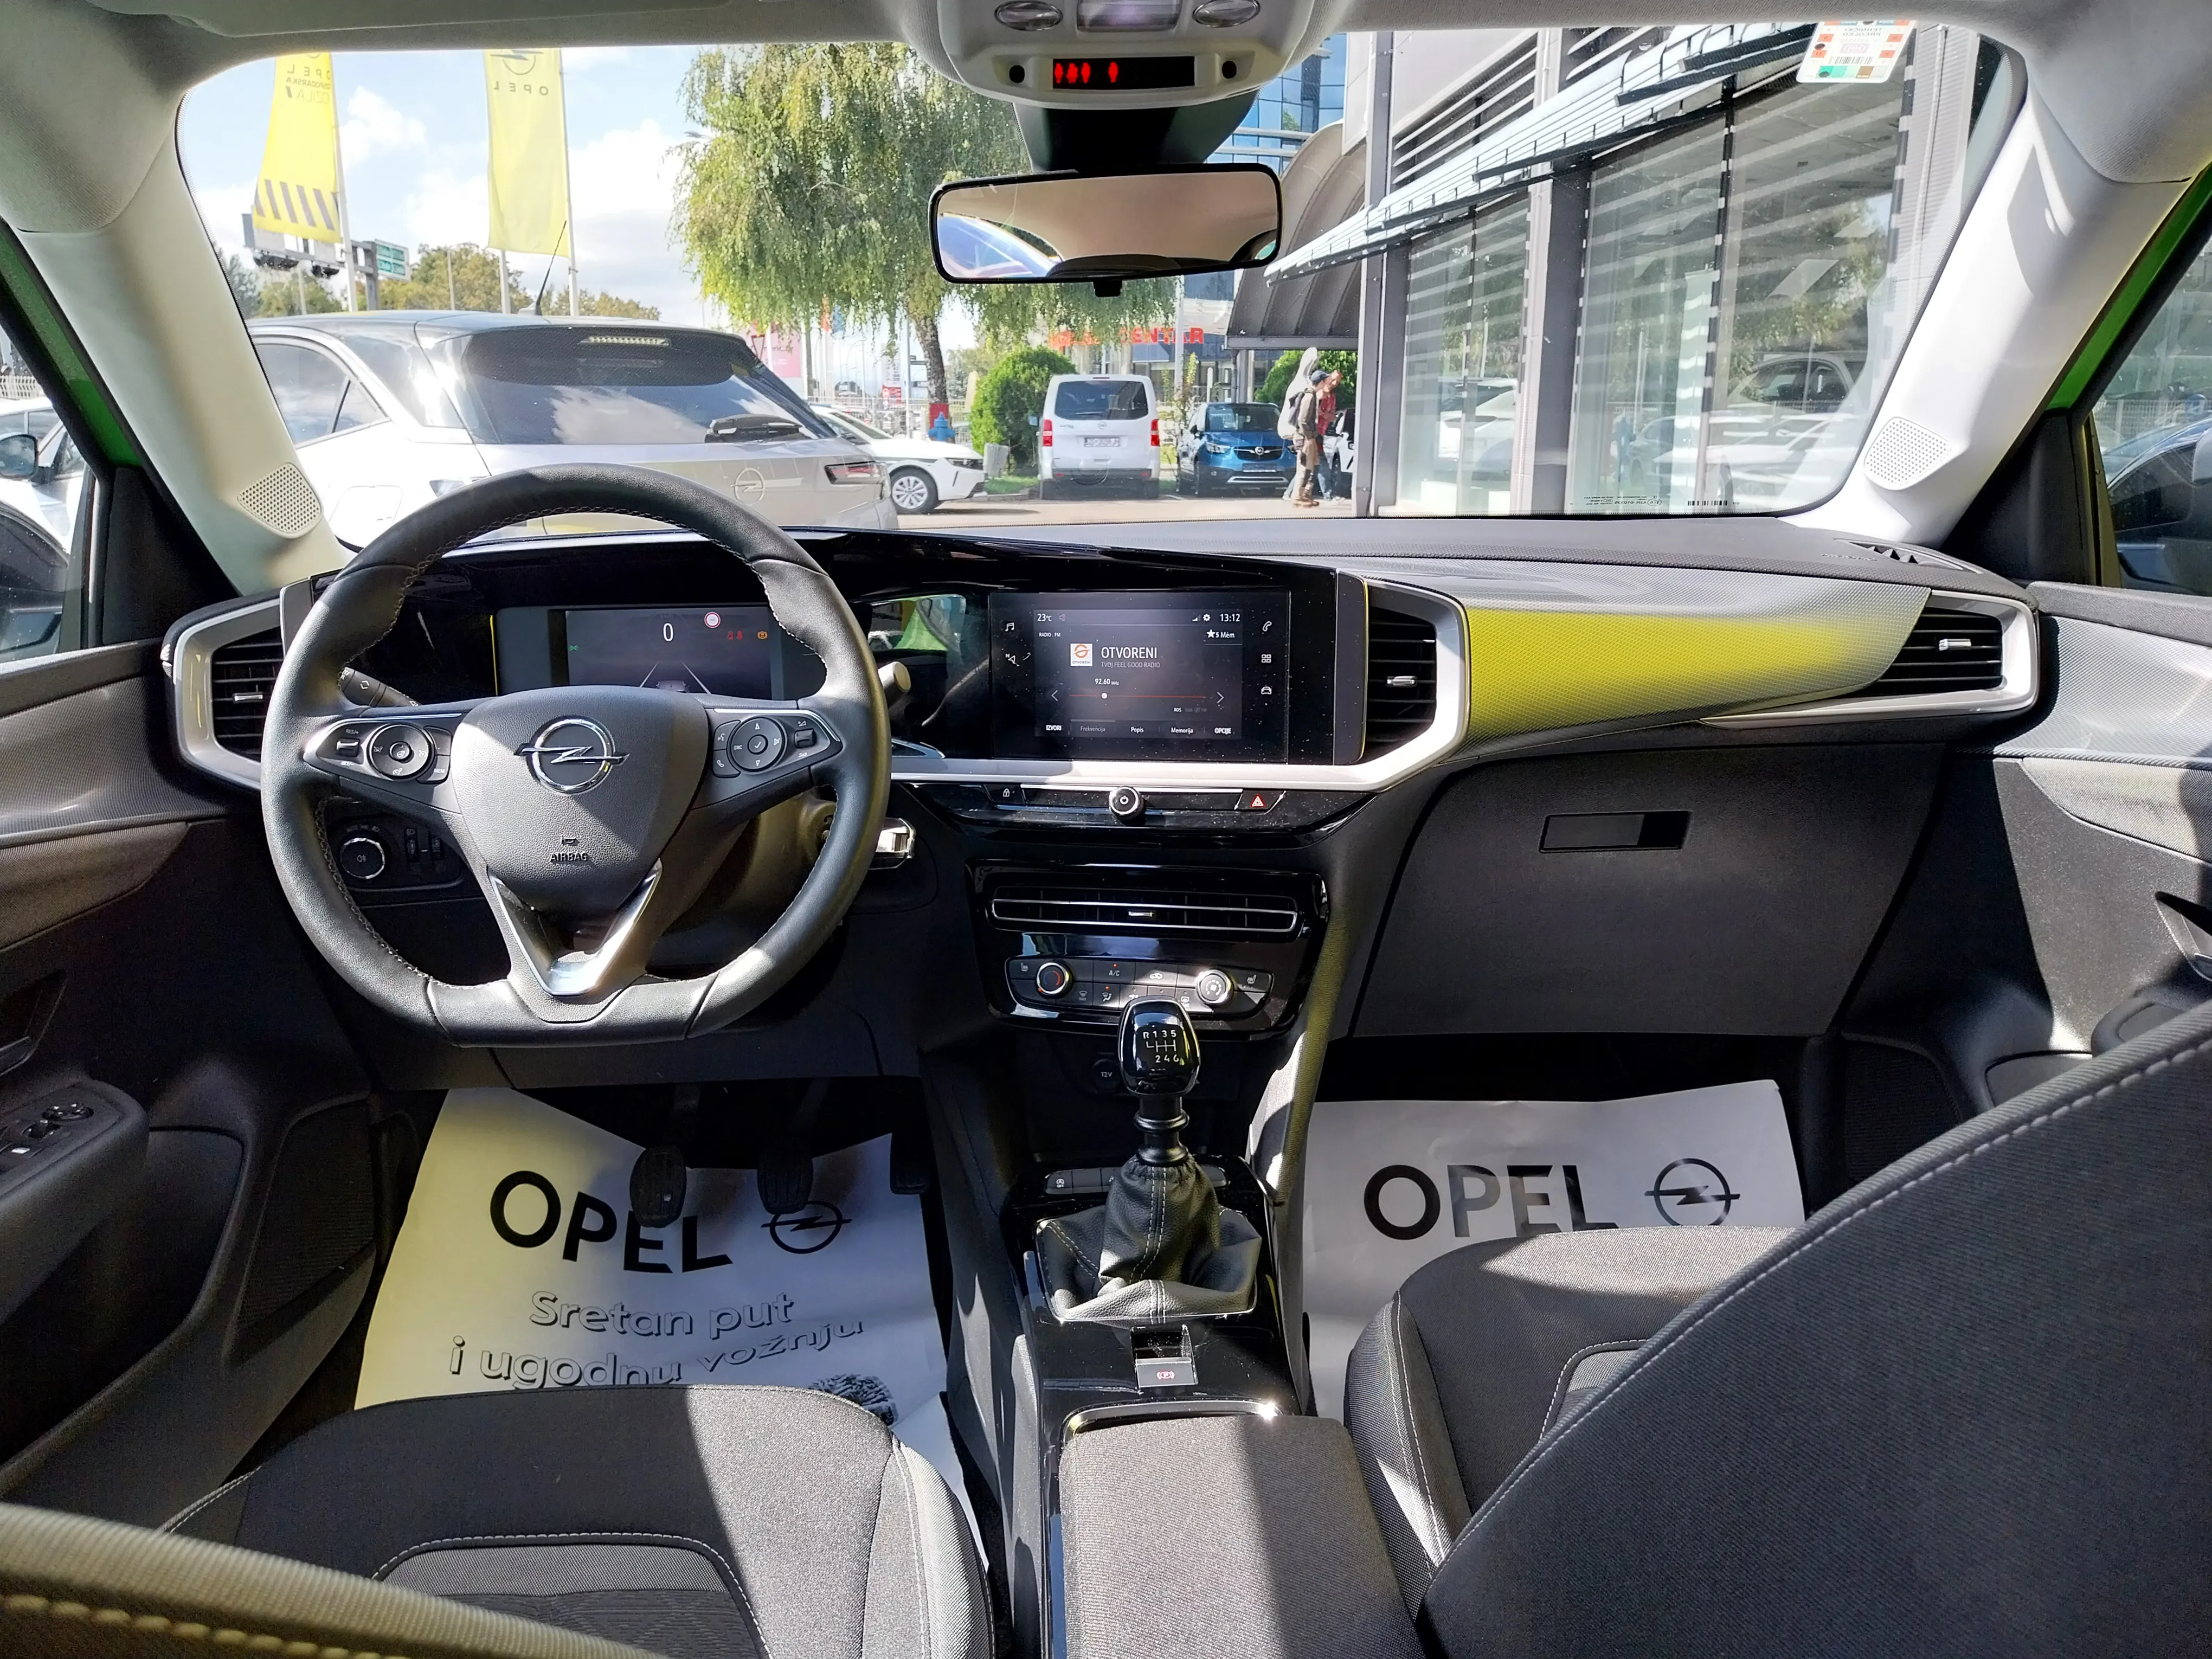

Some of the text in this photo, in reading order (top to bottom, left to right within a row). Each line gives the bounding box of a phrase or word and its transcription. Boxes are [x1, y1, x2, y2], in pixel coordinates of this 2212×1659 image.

[1037, 613, 1052, 622] 23°C
[1219, 613, 1240, 622] 13:12
[662, 622, 674, 642] 0
[1101, 646, 1158, 659] OTVORENI
[549, 852, 589, 862] AIRBAG
[1143, 1029, 1177, 1039] R 1 3 5
[1155, 1054, 1179, 1063] 2 4 6
[1364, 1164, 1618, 1240] OPEL
[490, 1170, 733, 1274] OPEL
[531, 1290, 794, 1340] Sretan put
[449, 1335, 466, 1374] i
[479, 1349, 683, 1390] ugodnu
